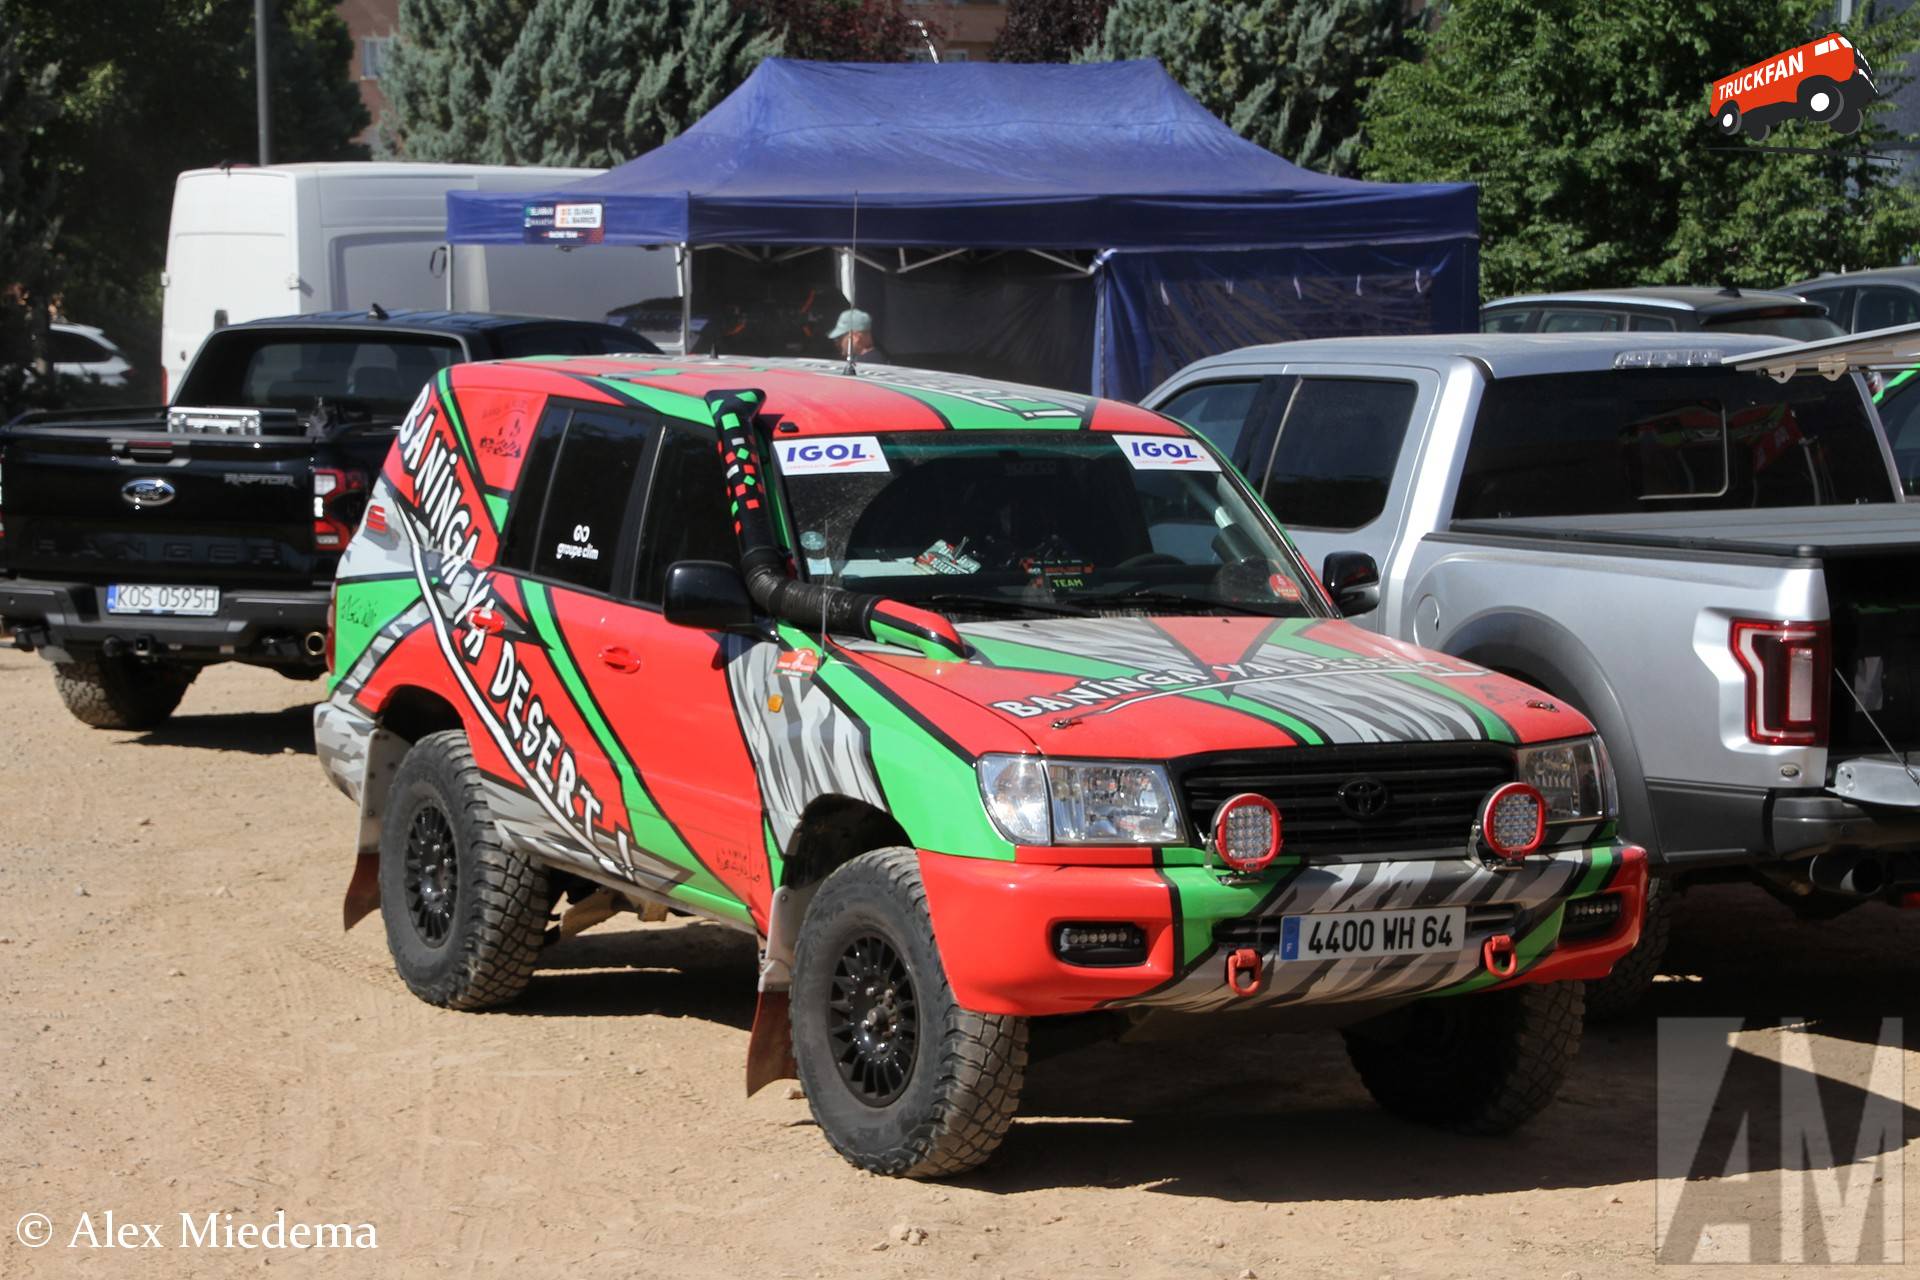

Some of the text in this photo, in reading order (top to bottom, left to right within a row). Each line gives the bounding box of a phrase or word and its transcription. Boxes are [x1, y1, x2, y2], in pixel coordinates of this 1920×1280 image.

[224, 473, 297, 488] RAPTOR
[1052, 579, 1084, 588] TEAM
[117, 586, 216, 609] KOS 0595H
[1212, 661, 1286, 678] YA
[491, 640, 602, 843] DESERT
[1308, 914, 1453, 954] 4400 WH 64
